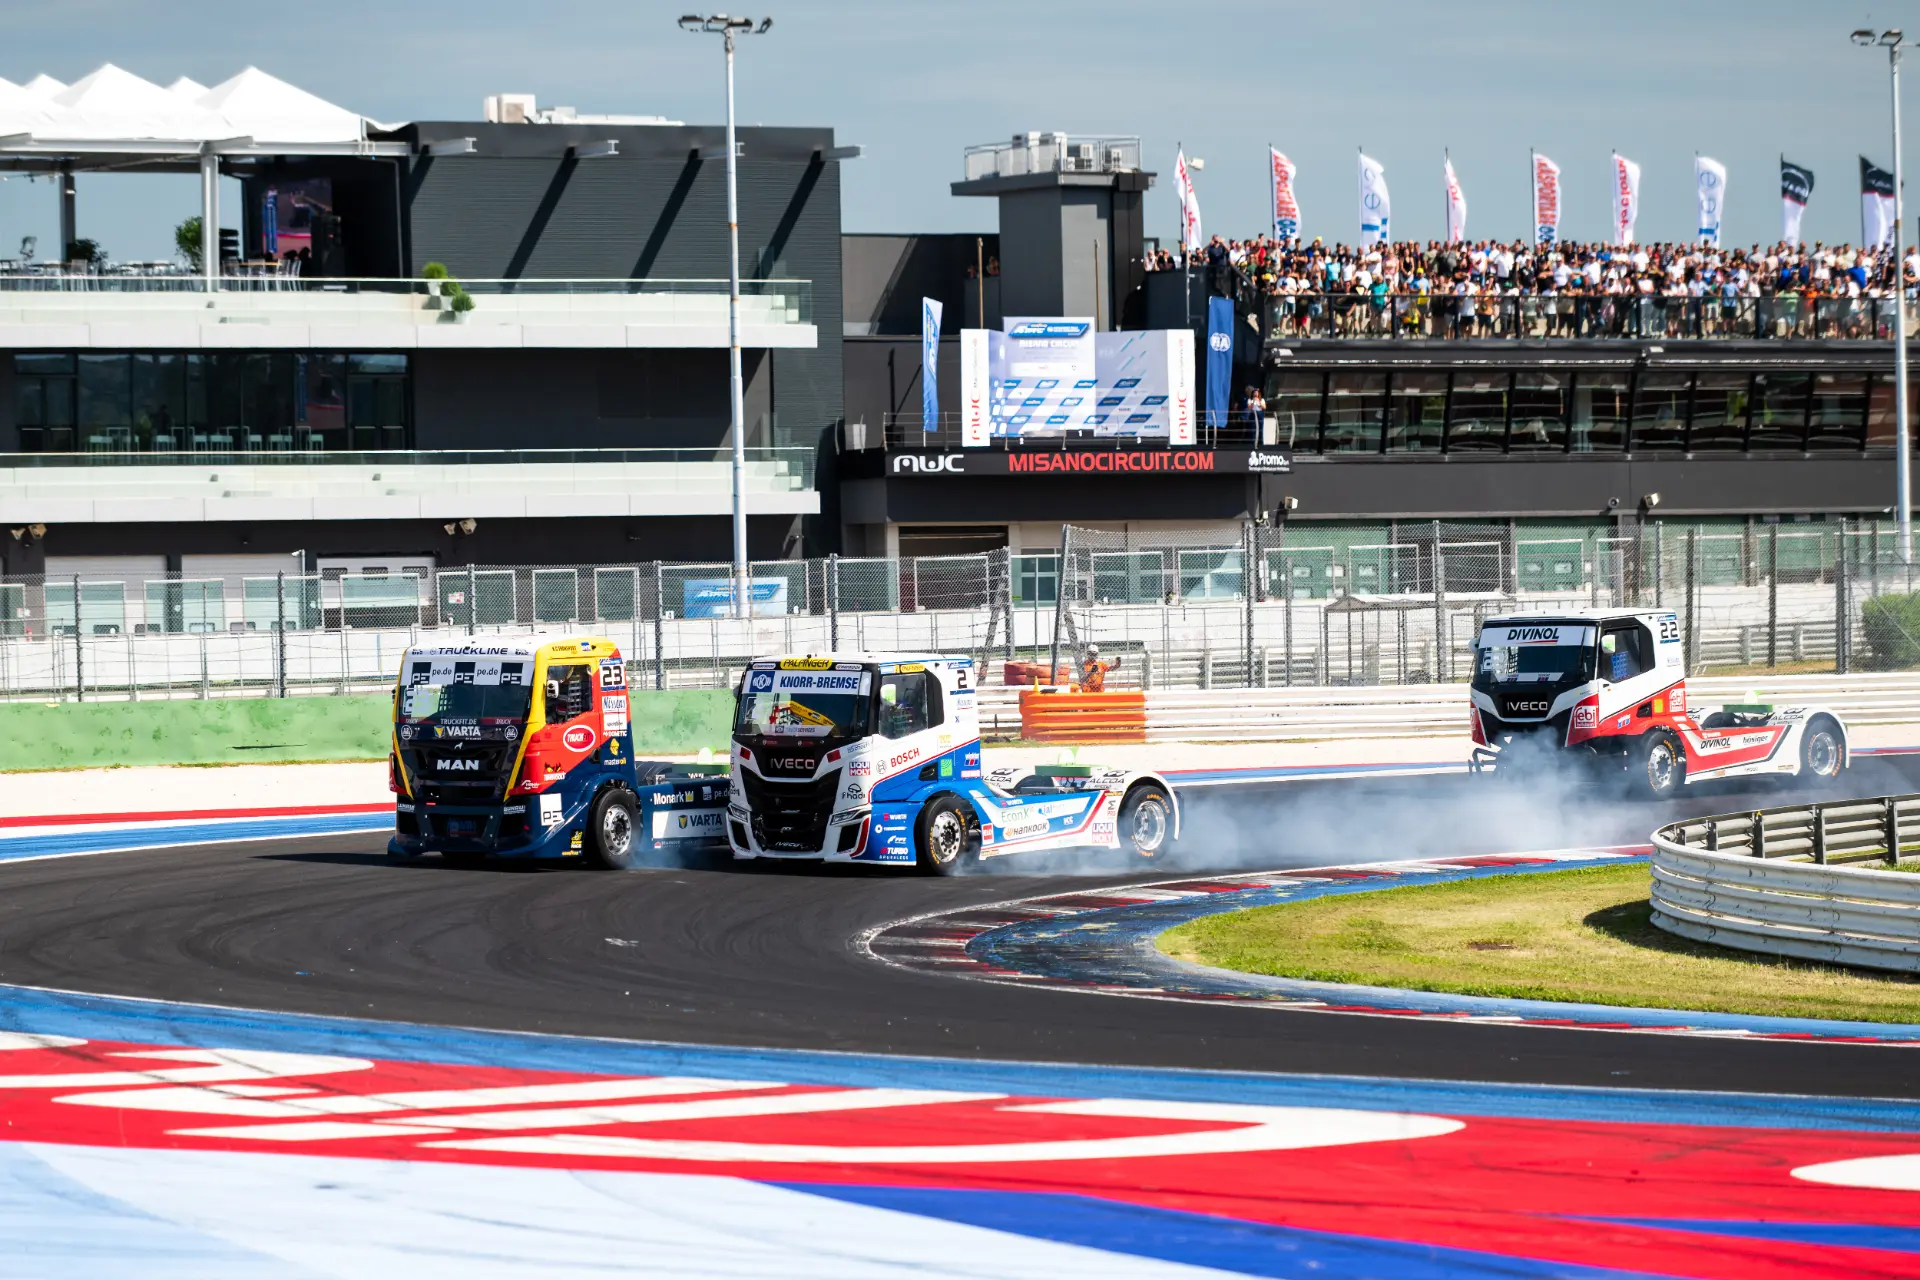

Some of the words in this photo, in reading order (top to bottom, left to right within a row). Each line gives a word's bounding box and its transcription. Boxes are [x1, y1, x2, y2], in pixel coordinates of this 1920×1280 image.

[1008, 451, 1215, 472] MISANOCIRCUIT.COM
[1258, 452, 1284, 466] Promo
[1507, 628, 1559, 640] DIVINOL
[1660, 622, 1678, 639] 22
[438, 647, 508, 655] TRUCKLINE
[783, 659, 829, 668] PALFINGER
[432, 667, 452, 677] pe.de
[477, 667, 498, 677] pe.de
[602, 665, 622, 686] 23
[780, 676, 859, 689] KNORR-BREMSE
[957, 669, 967, 689] 2
[1507, 701, 1548, 711] IVECO
[446, 726, 481, 736] VARTA
[1701, 738, 1731, 749] DIVINOL
[770, 758, 815, 769] IVECO
[890, 747, 920, 768] BOSCH
[436, 759, 479, 770] MAN
[653, 792, 684, 805] Monark
[690, 813, 723, 827] VARTA
